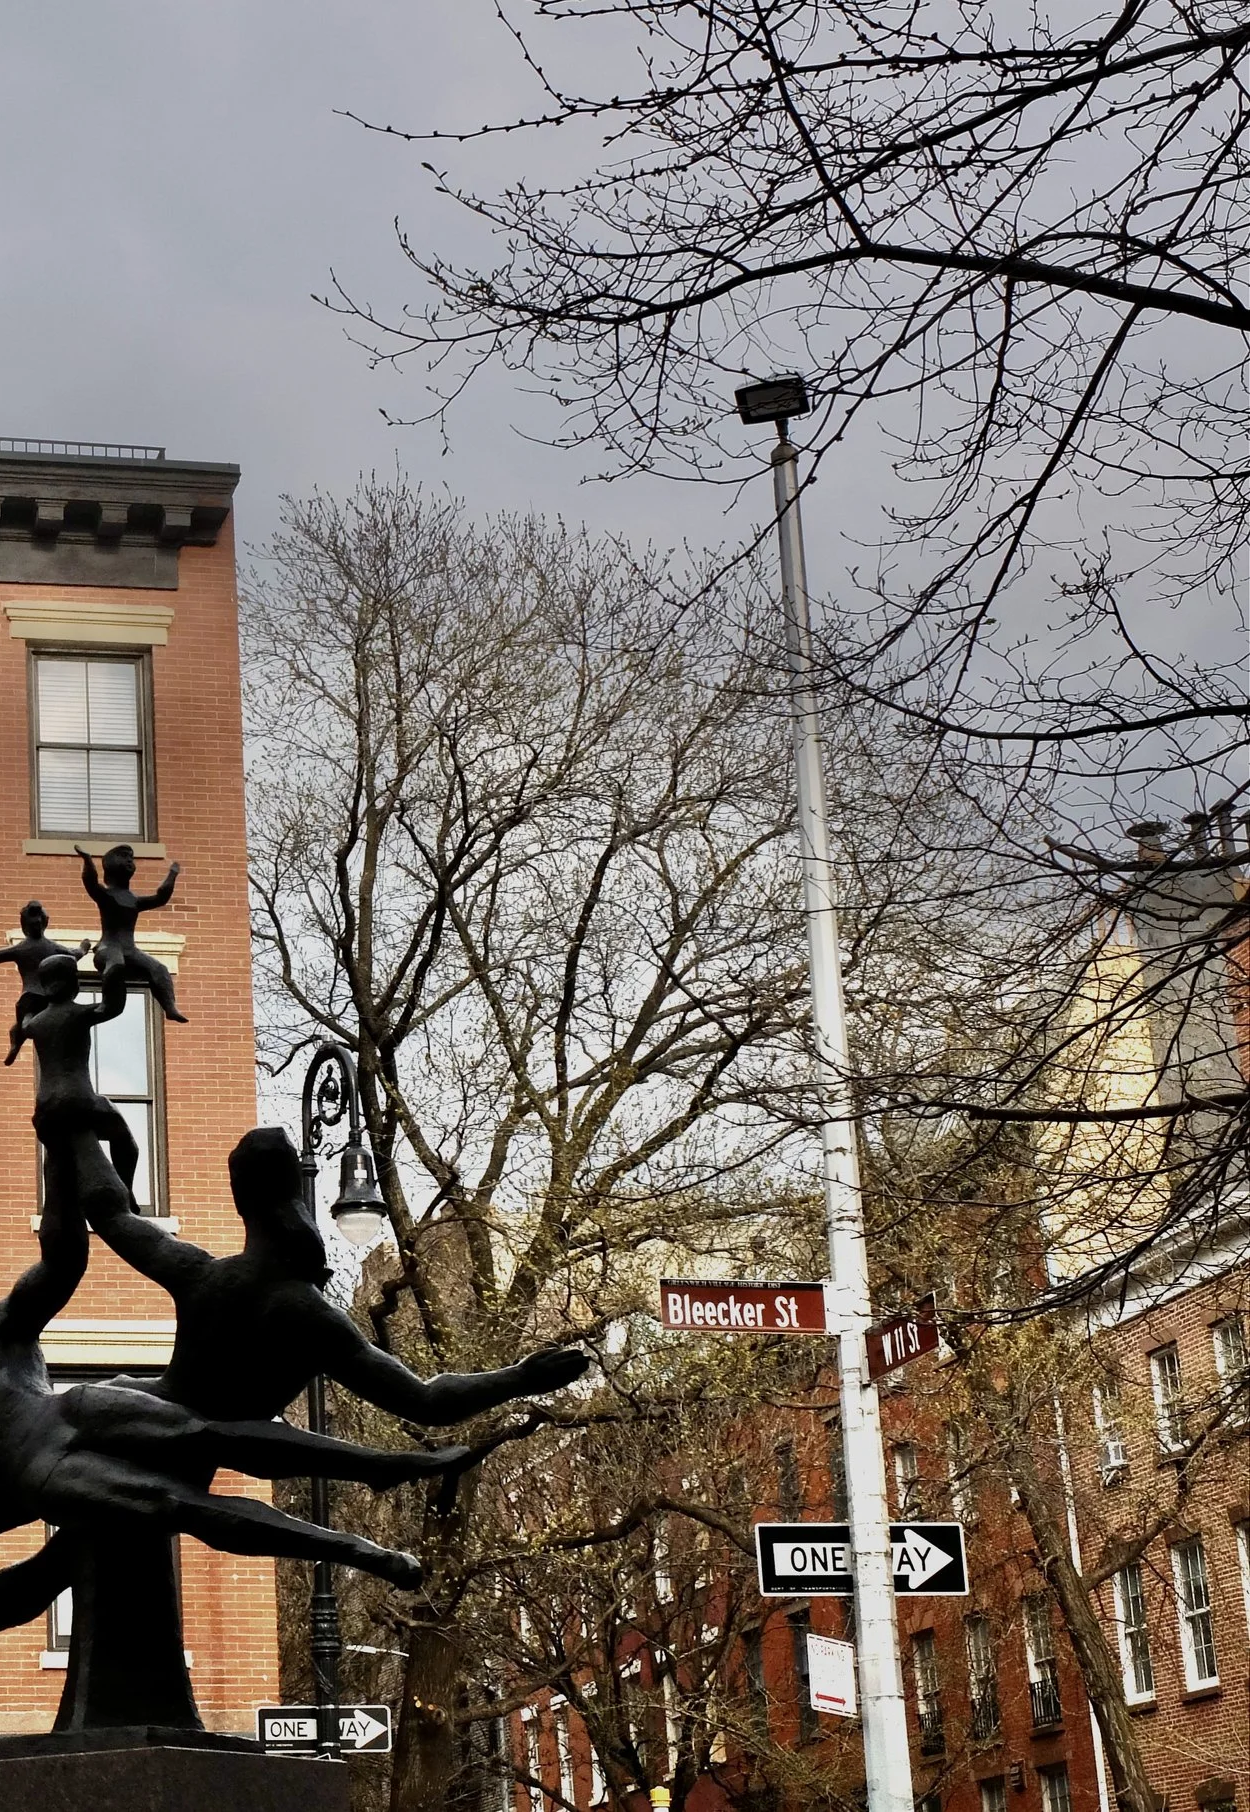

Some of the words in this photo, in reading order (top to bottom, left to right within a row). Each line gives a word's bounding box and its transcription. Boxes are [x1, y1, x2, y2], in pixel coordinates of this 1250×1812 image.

[667, 1293, 766, 1327] Bleecker
[775, 1296, 800, 1328] St
[881, 1332, 893, 1366] W
[894, 1326, 905, 1360] 11
[907, 1320, 920, 1353] St
[790, 1547, 848, 1572] ONE
[891, 1547, 932, 1572] AY
[270, 1721, 307, 1737] ONE
